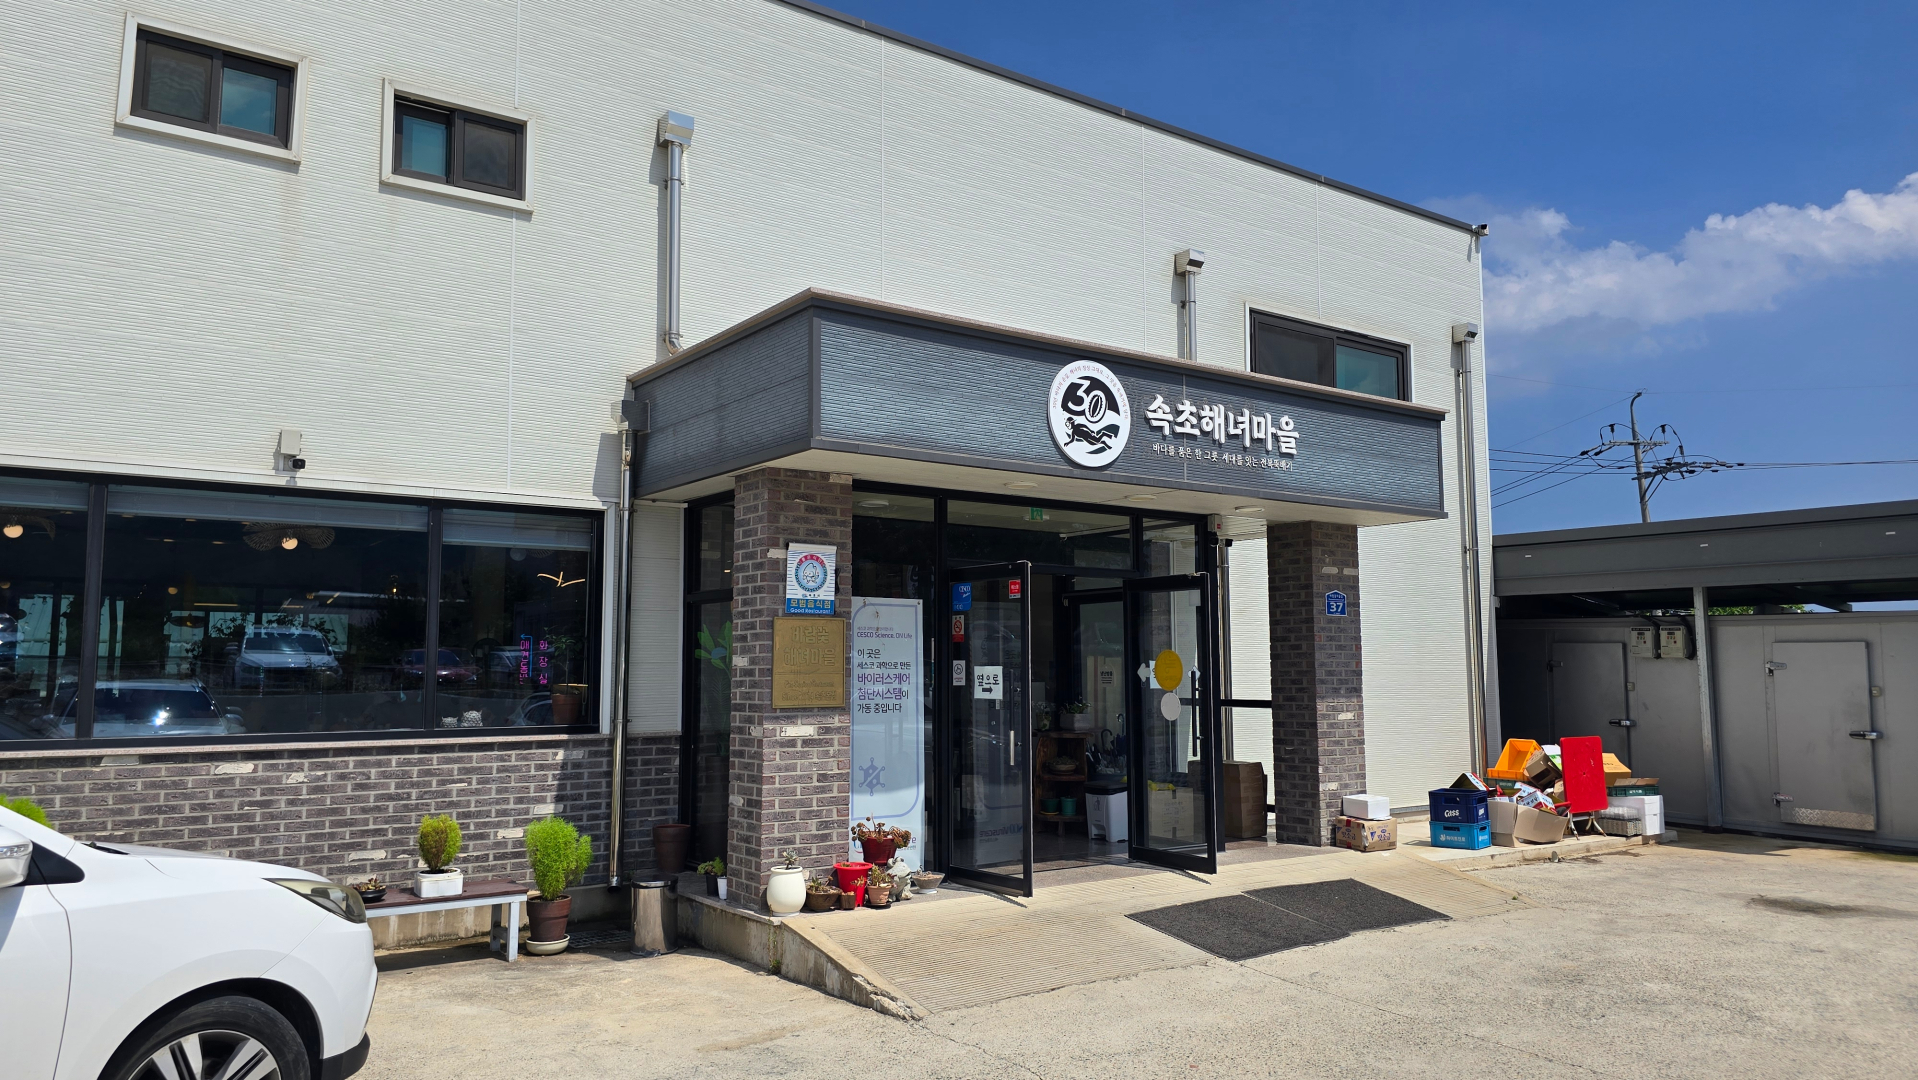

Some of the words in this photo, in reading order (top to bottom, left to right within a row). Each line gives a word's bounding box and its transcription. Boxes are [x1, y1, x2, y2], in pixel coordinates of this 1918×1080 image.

[1067, 380, 1107, 423] 30
[1145, 393, 1300, 455] 속초해녀마을
[1152, 442, 1174, 456] 바다를
[1177, 446, 1193, 459] 품은
[1194, 448, 1203, 460] 한
[1204, 450, 1219, 462] 그릇
[1221, 455, 1244, 466] 세대를
[790, 599, 831, 609] 모범음식점
[1329, 602, 1343, 612] 37
[783, 646, 836, 667] 해녀마을
[857, 648, 865, 658] 이
[866, 648, 881, 659] 곳은
[539, 641, 548, 685] 화장실
[856, 661, 875, 670] 세스코
[875, 661, 899, 670] 과학으로
[899, 661, 911, 670] 만든
[857, 672, 911, 685] 바이러스케어
[977, 673, 1000, 687] 옆으로
[857, 687, 909, 701] 첨단시스템이
[857, 703, 872, 714] 가동
[873, 703, 902, 714] 중입니다
[1444, 809, 1460, 818] Cass
